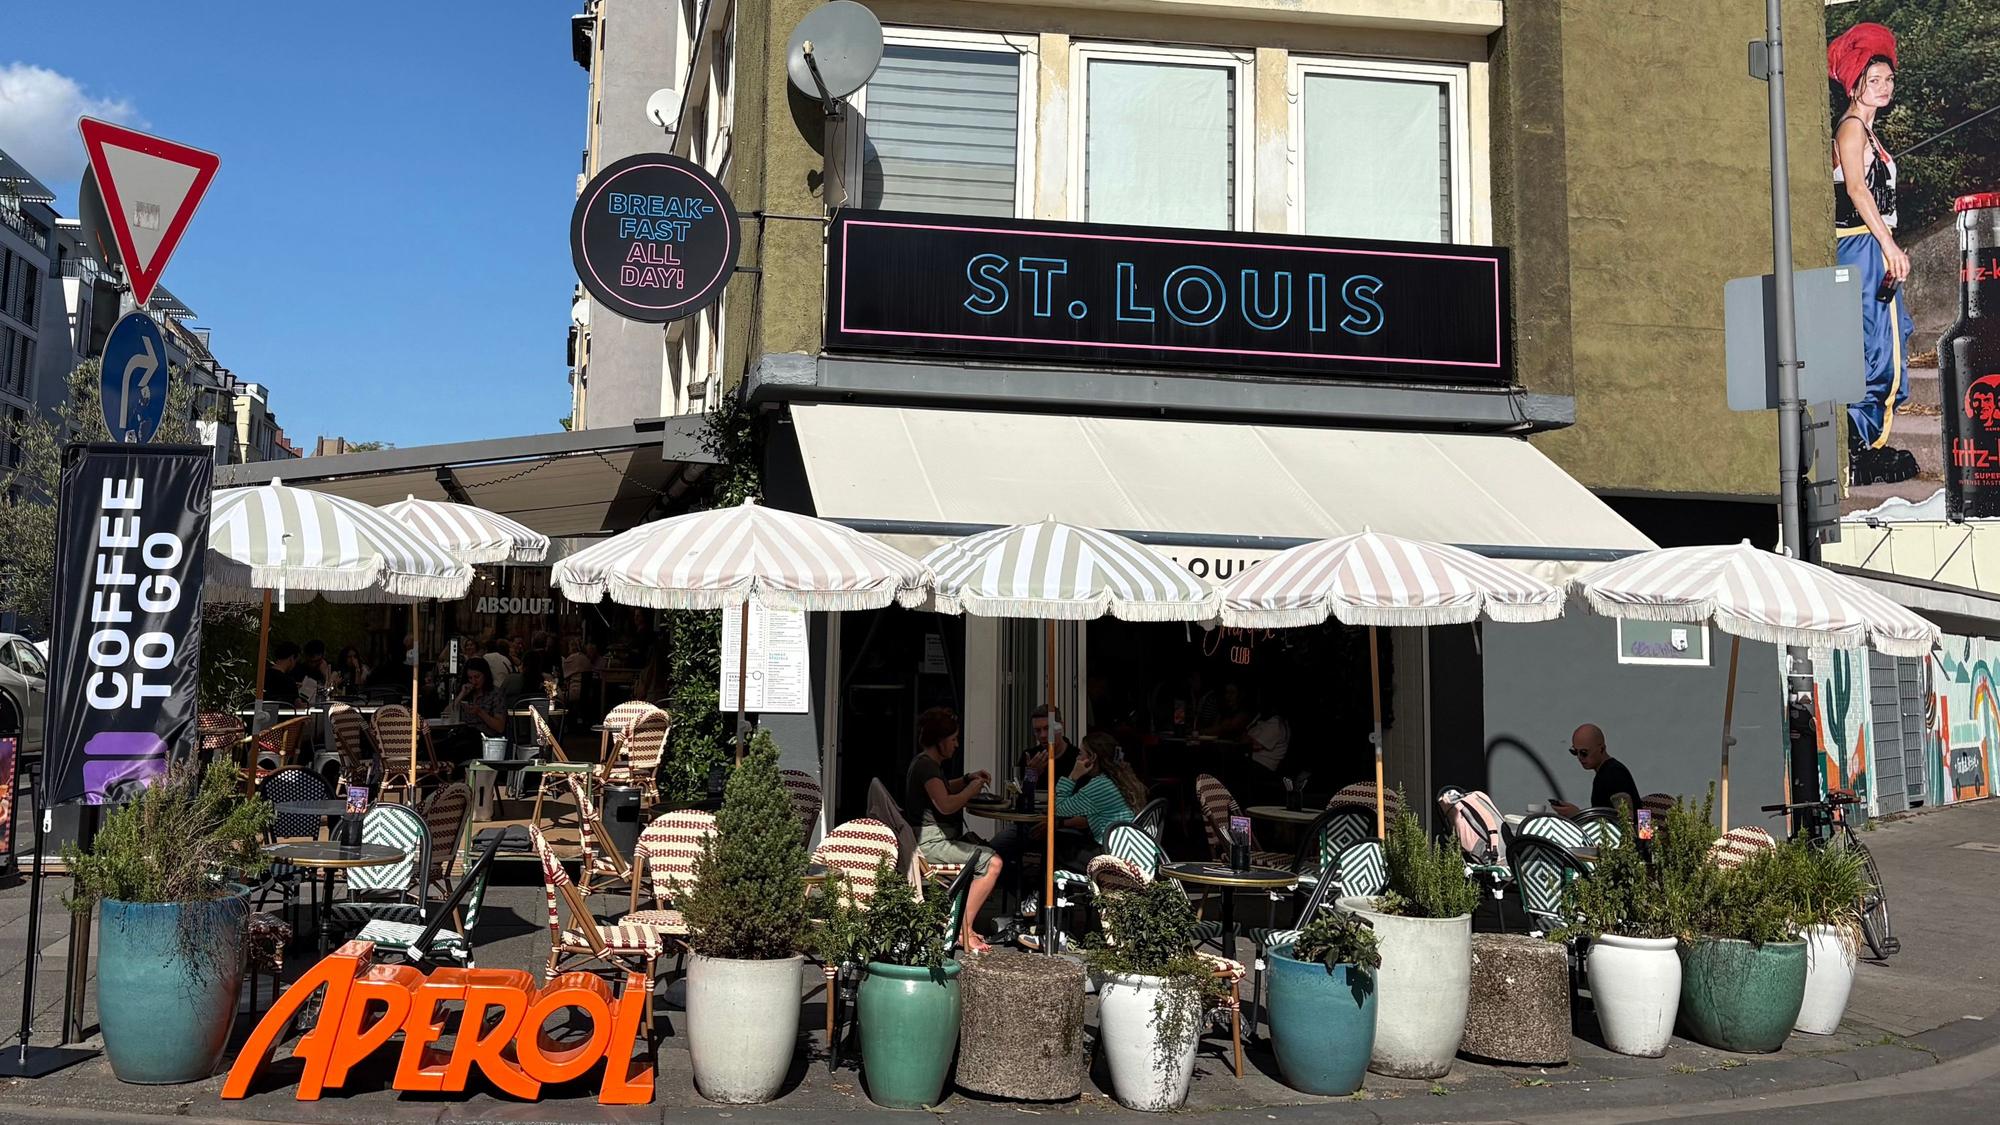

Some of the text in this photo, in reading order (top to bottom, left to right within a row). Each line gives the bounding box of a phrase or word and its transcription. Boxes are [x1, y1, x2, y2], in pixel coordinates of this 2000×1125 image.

[608, 192, 714, 219] BREAK-
[619, 217, 691, 242] FAST
[626, 242, 681, 265] ALL
[620, 265, 685, 290] DAY!
[963, 253, 1385, 336] ST. LOUIS
[1982, 479, 2000, 487] TAST
[1171, 556, 1262, 580] OUI
[86, 477, 144, 710] COFFEE
[131, 532, 183, 709] TO GO
[1230, 645, 1250, 665] CLUB
[220, 940, 655, 1105] APEROL
